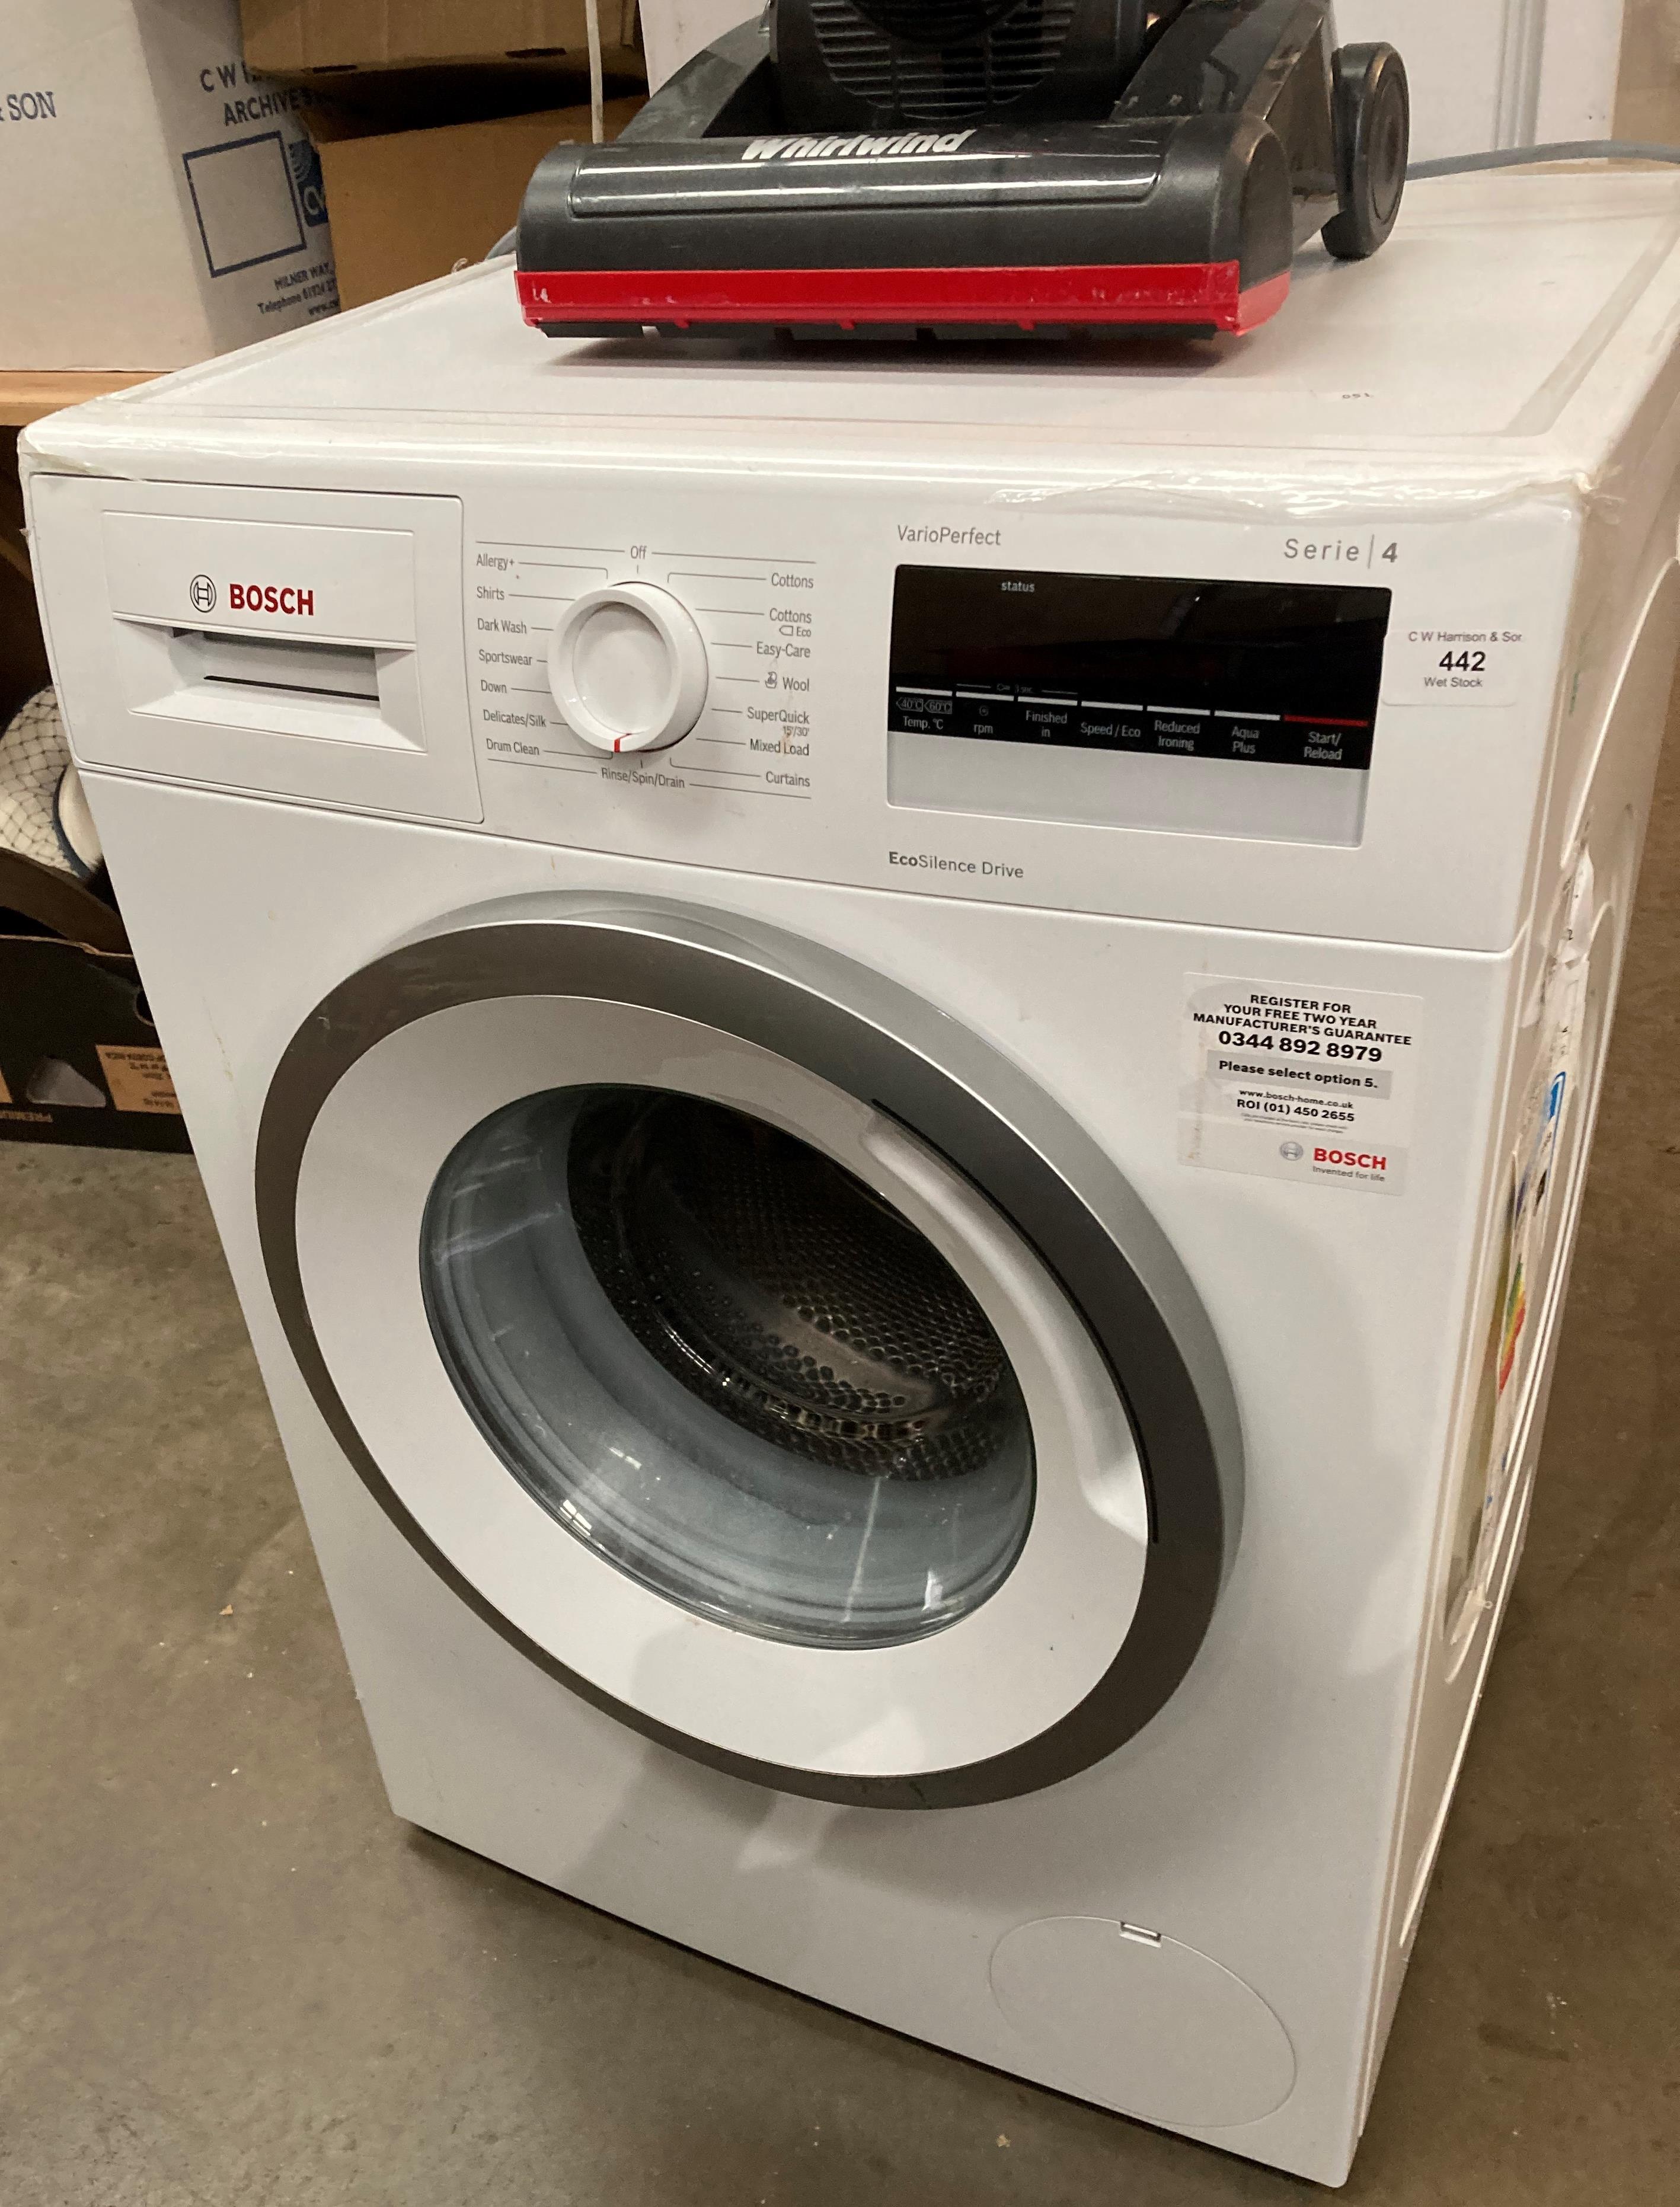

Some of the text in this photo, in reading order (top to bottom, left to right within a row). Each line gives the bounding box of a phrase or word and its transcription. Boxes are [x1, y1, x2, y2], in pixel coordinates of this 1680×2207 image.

[200, 69, 214, 92] C
[216, 63, 236, 88] W
[7, 91, 56, 120] SON
[742, 129, 977, 160] Whirlwind
[898, 525, 1001, 545] VarioPerfect
[631, 545, 647, 559] Off
[1284, 538, 1398, 563] Serie 4
[477, 554, 515, 570] Allergy+
[771, 573, 814, 589] Cottons
[1001, 580, 1035, 593] status
[229, 583, 314, 615] BOSCH
[477, 586, 504, 600] Shirts
[769, 608, 812, 624] Cottons
[477, 618, 527, 634] Dark Wash
[796, 626, 812, 637] Eco
[1408, 631, 1417, 641] C
[1421, 631, 1433, 641] W
[1438, 631, 1486, 642] Harrison
[1490, 631, 1499, 642] &
[479, 649, 532, 665] Sportswear
[756, 641, 811, 659] Easy-Care
[1439, 651, 1486, 672] 442
[481, 679, 507, 694] Down
[783, 677, 810, 692] Wool
[1424, 678, 1483, 688] Wet Stock
[483, 709, 547, 727] Delicates/Silk
[747, 706, 810, 724] SuperQuick
[903, 716, 931, 730] Temp.
[1026, 710, 1067, 724] Finished
[973, 724, 994, 734] rpm
[1042, 727, 1050, 737] in
[1081, 722, 1113, 736] Speed
[1122, 726, 1141, 737] Eco
[1154, 720, 1200, 735] Reduced
[1231, 726, 1260, 740] Aqua
[486, 739, 539, 755] Drum Clean
[1158, 736, 1194, 752] Ironing
[1308, 732, 1342, 746] Start/
[750, 739, 810, 756] Mixed Load
[1233, 741, 1256, 754] Plus
[1304, 746, 1342, 761] Reload
[601, 768, 685, 788] Rinse/Spin/Drain
[766, 771, 810, 787] Curtains
[889, 851, 1024, 878] EcoSilence Drive
[1250, 994, 1351, 1013] REGISTER FOR
[1224, 1004, 1376, 1029] YOUR FREE TWO YEAR
[1193, 1013, 1411, 1045] MANUFACTURER'S GUARANTEE
[1219, 1031, 1382, 1062] 0344 892 8979
[1219, 1060, 1378, 1088] Please select option 5.
[1239, 1090, 1353, 1109] www.bosch-home.co.uk
[1237, 1099, 1355, 1122] ROI (01) 450 2655
[1314, 1148, 1387, 1170] BOSCH
[1312, 1165, 1385, 1182] Invented for life
